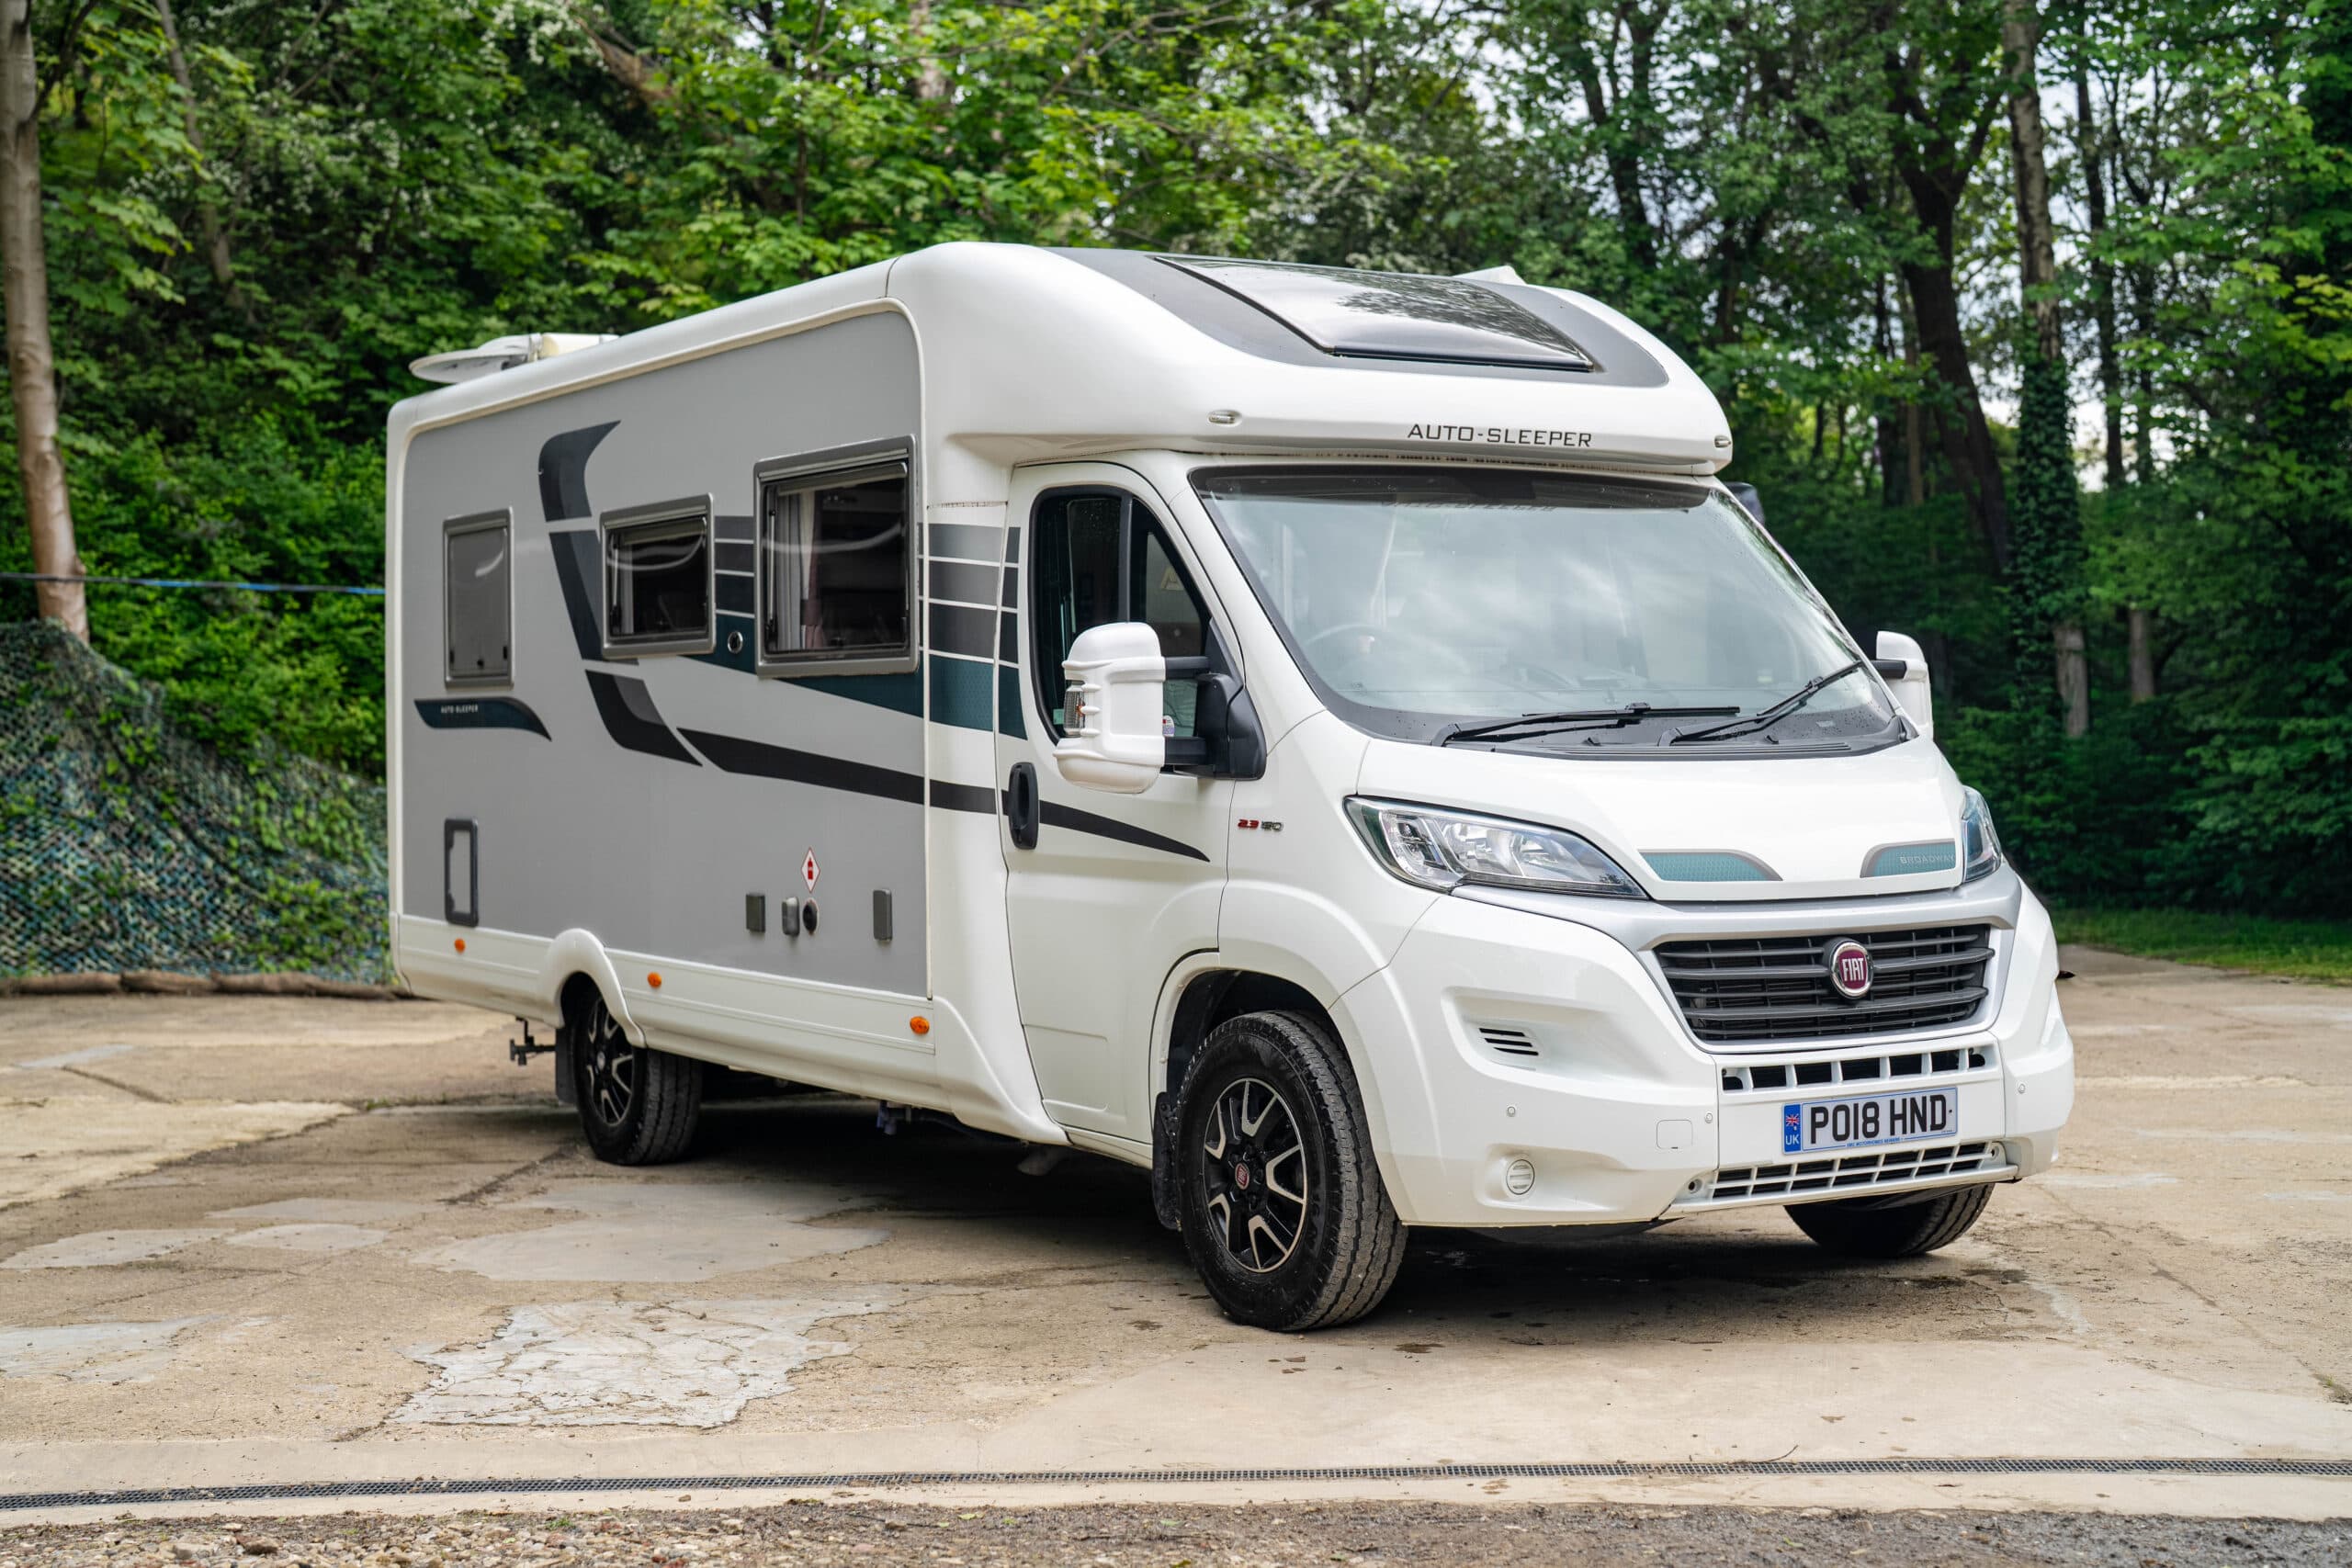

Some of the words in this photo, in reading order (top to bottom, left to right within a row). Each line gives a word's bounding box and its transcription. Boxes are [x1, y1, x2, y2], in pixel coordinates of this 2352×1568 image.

[1408, 423, 1592, 447] AUTO-SLEEPER
[1899, 853, 1955, 864] BROADWAY
[1841, 957, 1864, 982] FIAT
[1810, 1101, 1880, 1145] PO18
[1889, 1094, 1947, 1136] HND
[1785, 1134, 1800, 1145] UK
